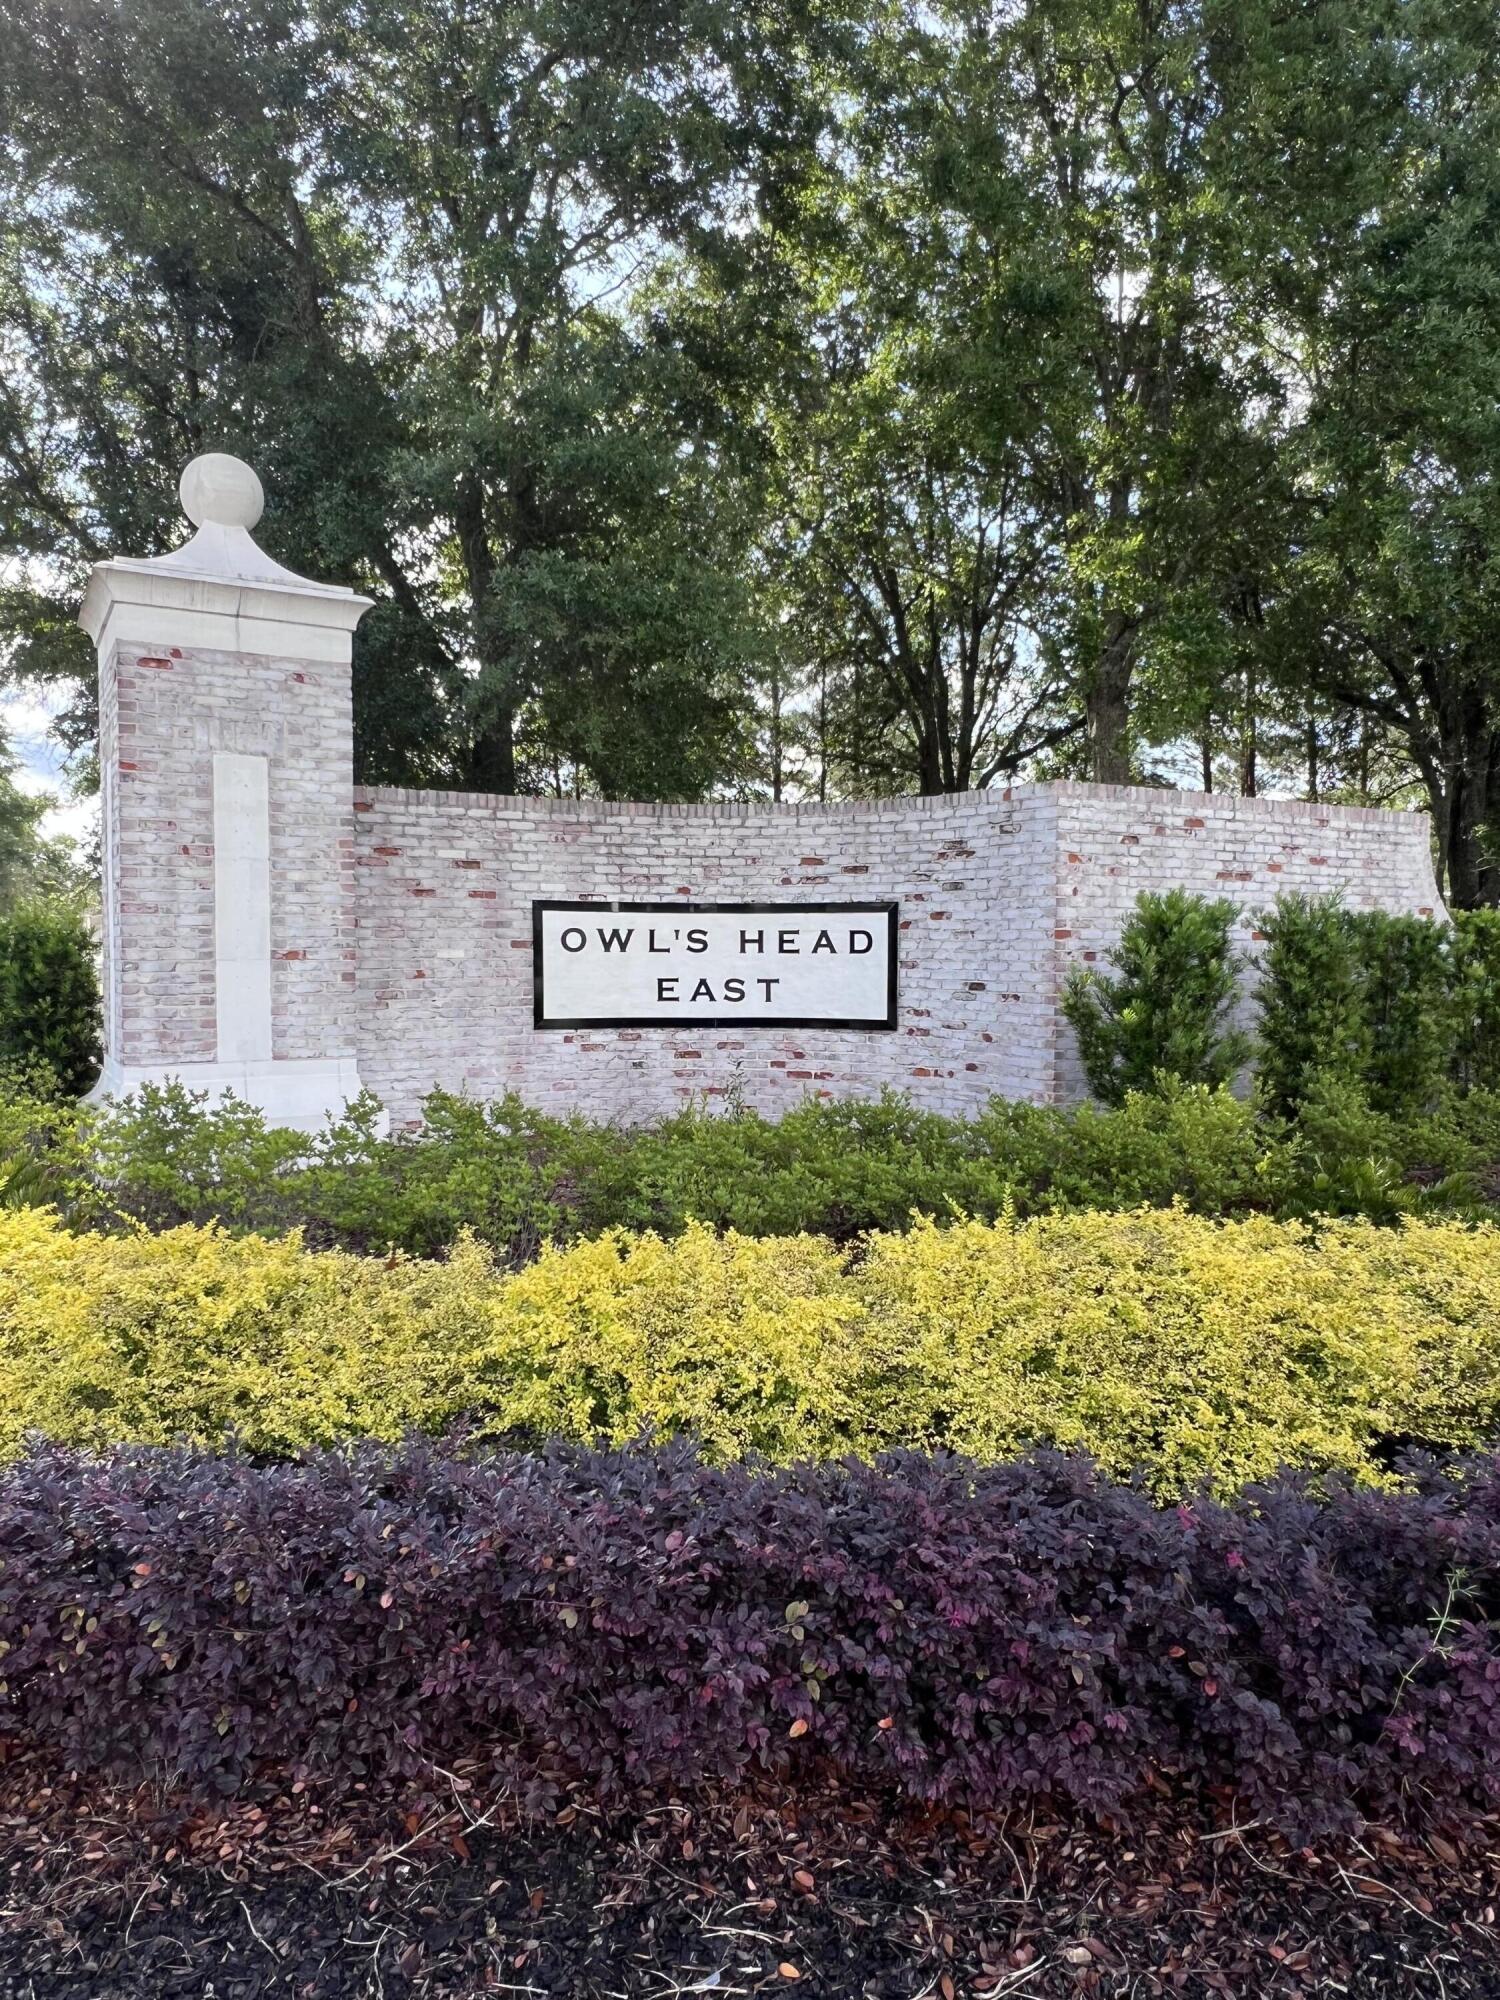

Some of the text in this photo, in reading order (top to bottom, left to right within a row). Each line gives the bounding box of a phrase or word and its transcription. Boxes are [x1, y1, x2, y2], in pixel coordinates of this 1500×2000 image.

[560, 928, 873, 954] OWL'S HEAD
[657, 978, 779, 1003] EAST
